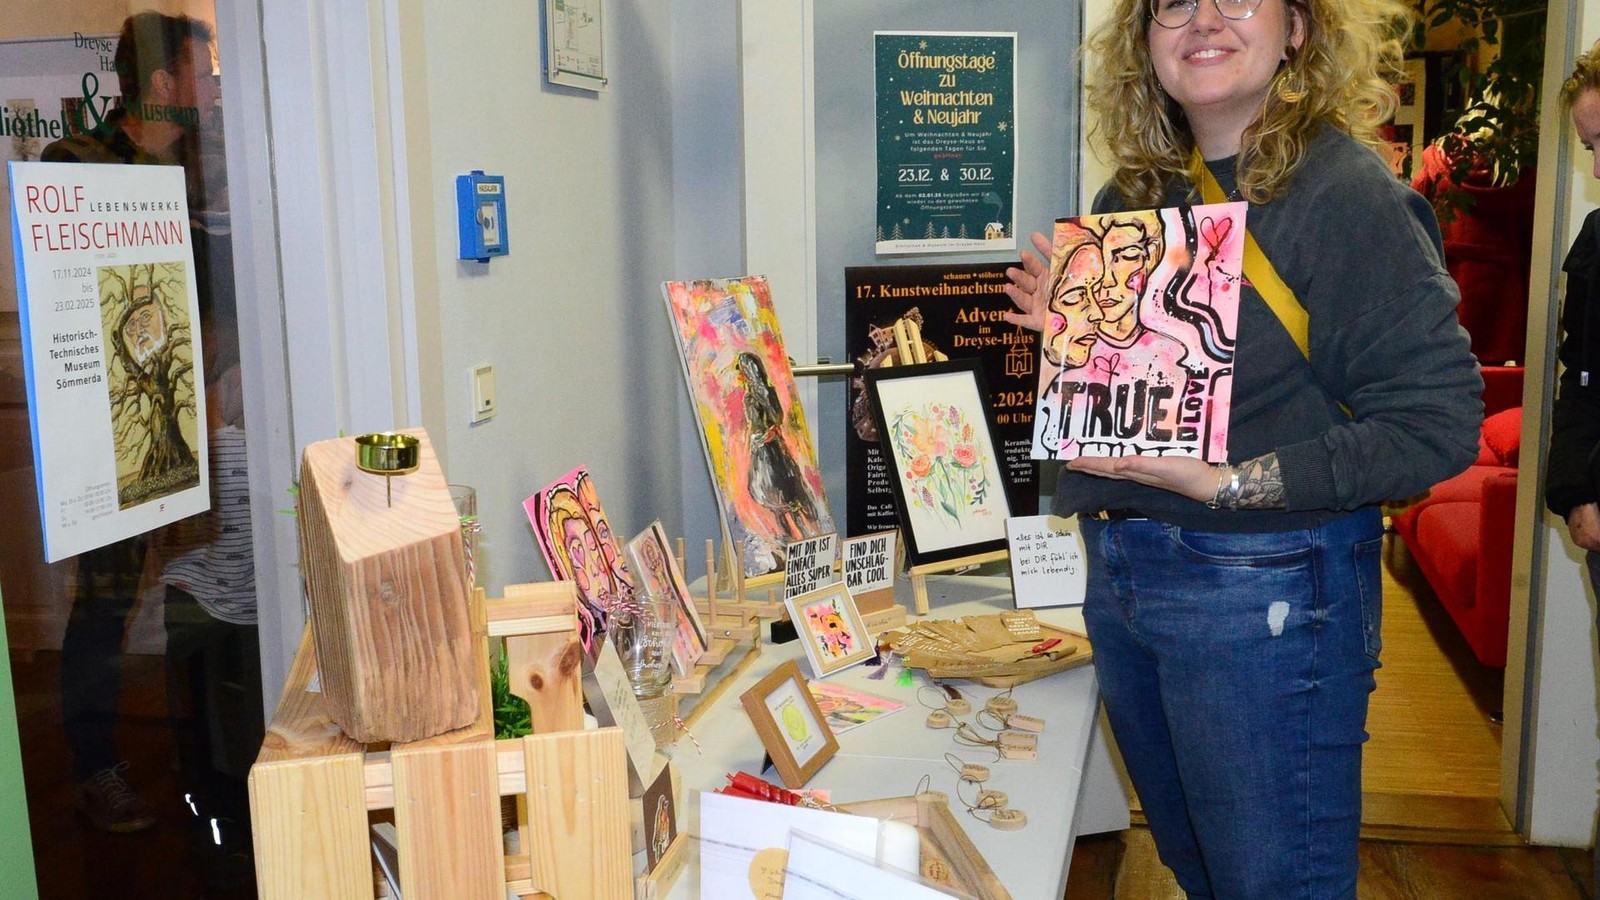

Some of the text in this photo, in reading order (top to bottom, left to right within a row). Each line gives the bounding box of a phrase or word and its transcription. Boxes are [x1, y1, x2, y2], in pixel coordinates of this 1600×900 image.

[74, 32, 112, 54] Dreyse
[898, 50, 996, 73] Öffnungstage
[938, 74, 956, 88] zu
[77, 72, 119, 136] &
[900, 89, 994, 106] Weihnachten
[913, 108, 982, 127] & Neujahr
[935, 138, 976, 146] Dreyse-Haus
[967, 131, 992, 139] Neujahr
[910, 145, 944, 153] folgenden
[945, 145, 964, 153] Tagen
[898, 167, 994, 182] 23.12. & 30.12.
[26, 185, 180, 214] ROLF LEBENSWERKE
[32, 220, 184, 251] FLEISCHMANN
[53, 267, 92, 280] 17.11.2024
[943, 271, 1004, 280] schauen stöbern
[82, 283, 93, 293] bis
[856, 283, 1006, 299] 17. Kunstweihnachtsm
[54, 299, 95, 312] 23.02.2025
[53, 328, 98, 344] Historisch-
[979, 325, 991, 334] im
[953, 333, 1034, 350] Dreyse-Haus
[50, 344, 99, 360] Technisches
[64, 359, 100, 373] Museum
[56, 373, 102, 390] Sömmerda
[1013, 413, 1033, 424] Uhr
[1052, 379, 1174, 442] TRUE
[867, 448, 880, 456] Mit
[1035, 532, 1044, 540] ist
[789, 537, 831, 559] MIT DIR IST
[850, 537, 886, 558] FIND DICH
[1019, 543, 1031, 551] mit
[787, 555, 816, 575] EINFACH
[845, 553, 889, 573] UNSCHLAG-
[1019, 557, 1030, 566] bei
[1034, 554, 1047, 564] DIR
[1069, 552, 1079, 561] ich
[786, 565, 831, 588] ALLES SUPER
[846, 566, 889, 588] BAR COOL.
[1021, 566, 1038, 576] mich
